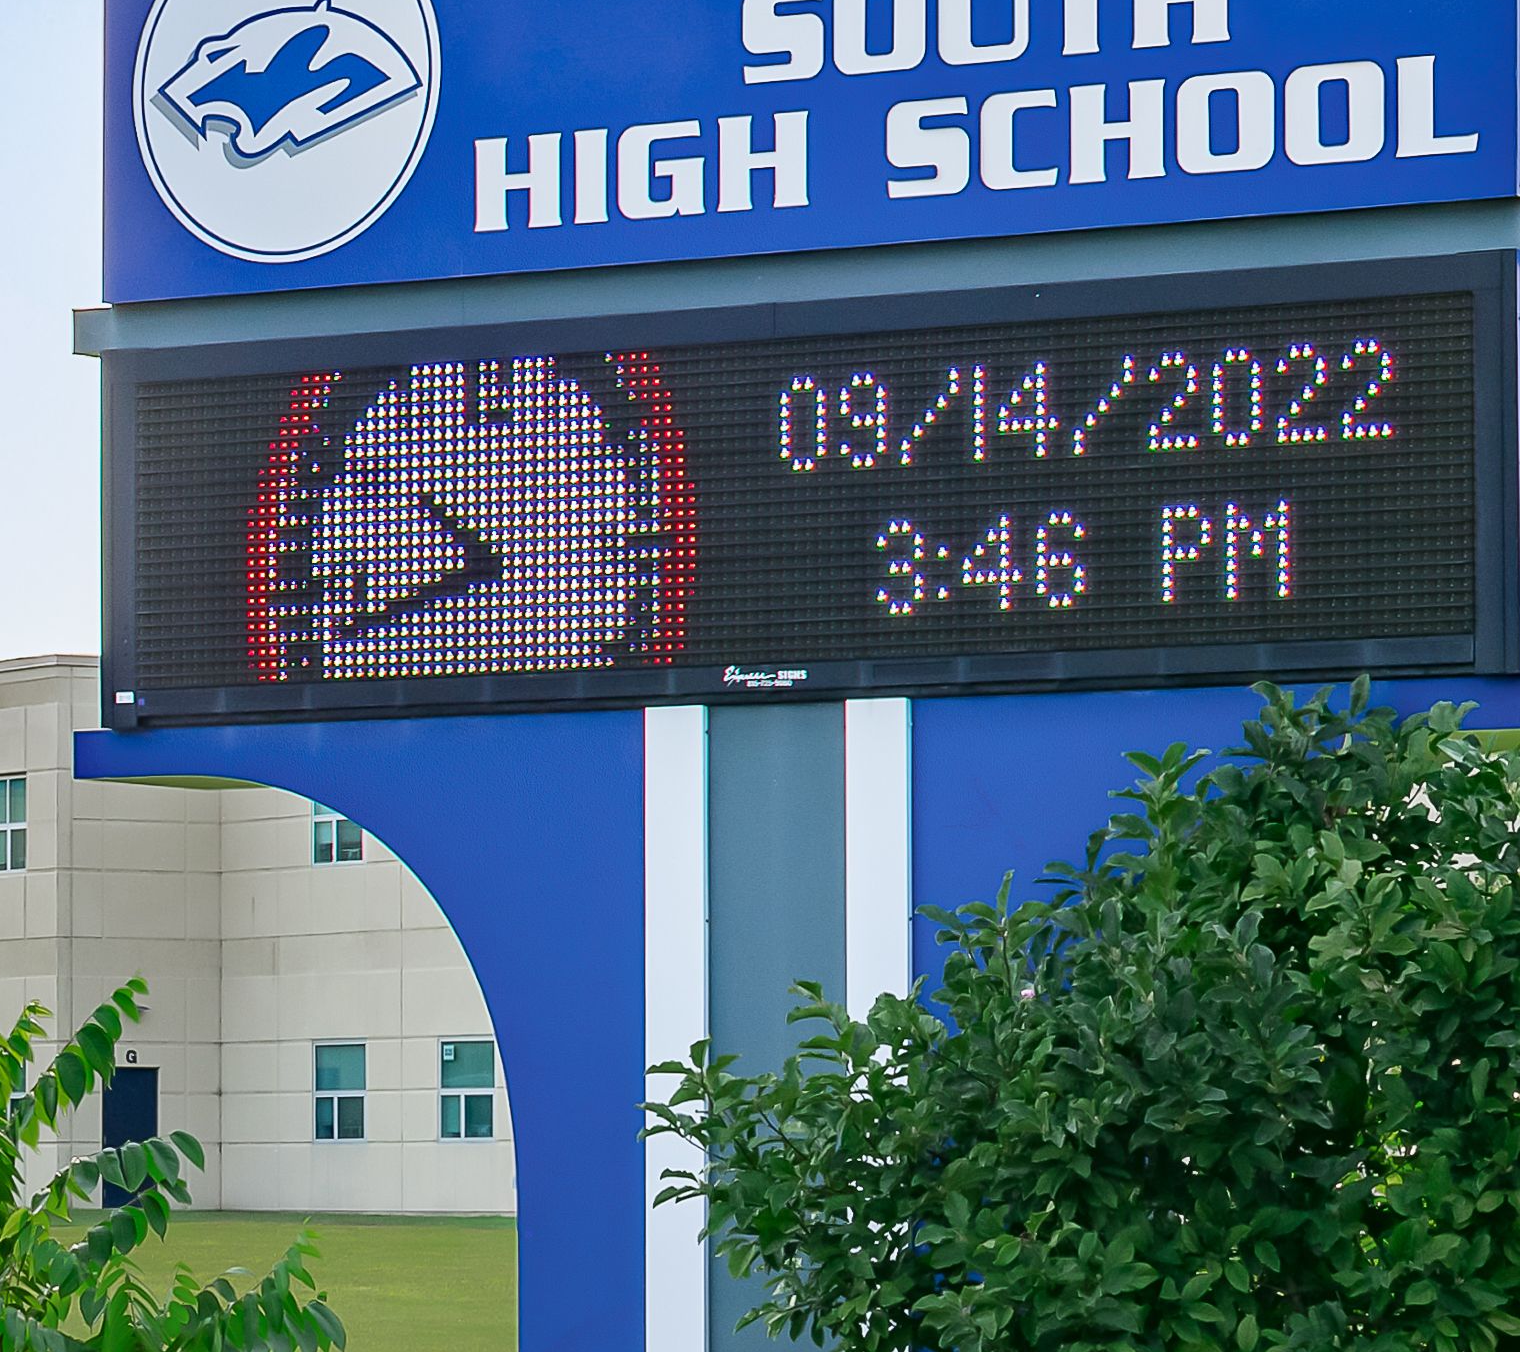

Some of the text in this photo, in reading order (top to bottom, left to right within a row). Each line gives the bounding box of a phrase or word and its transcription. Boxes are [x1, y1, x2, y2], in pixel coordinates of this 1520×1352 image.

[473, 55, 1479, 234] HIGH SCHOOL
[779, 339, 1394, 472] 09/14/2022
[876, 499, 1288, 615] 3:46 PM
[125, 1049, 138, 1065] G
